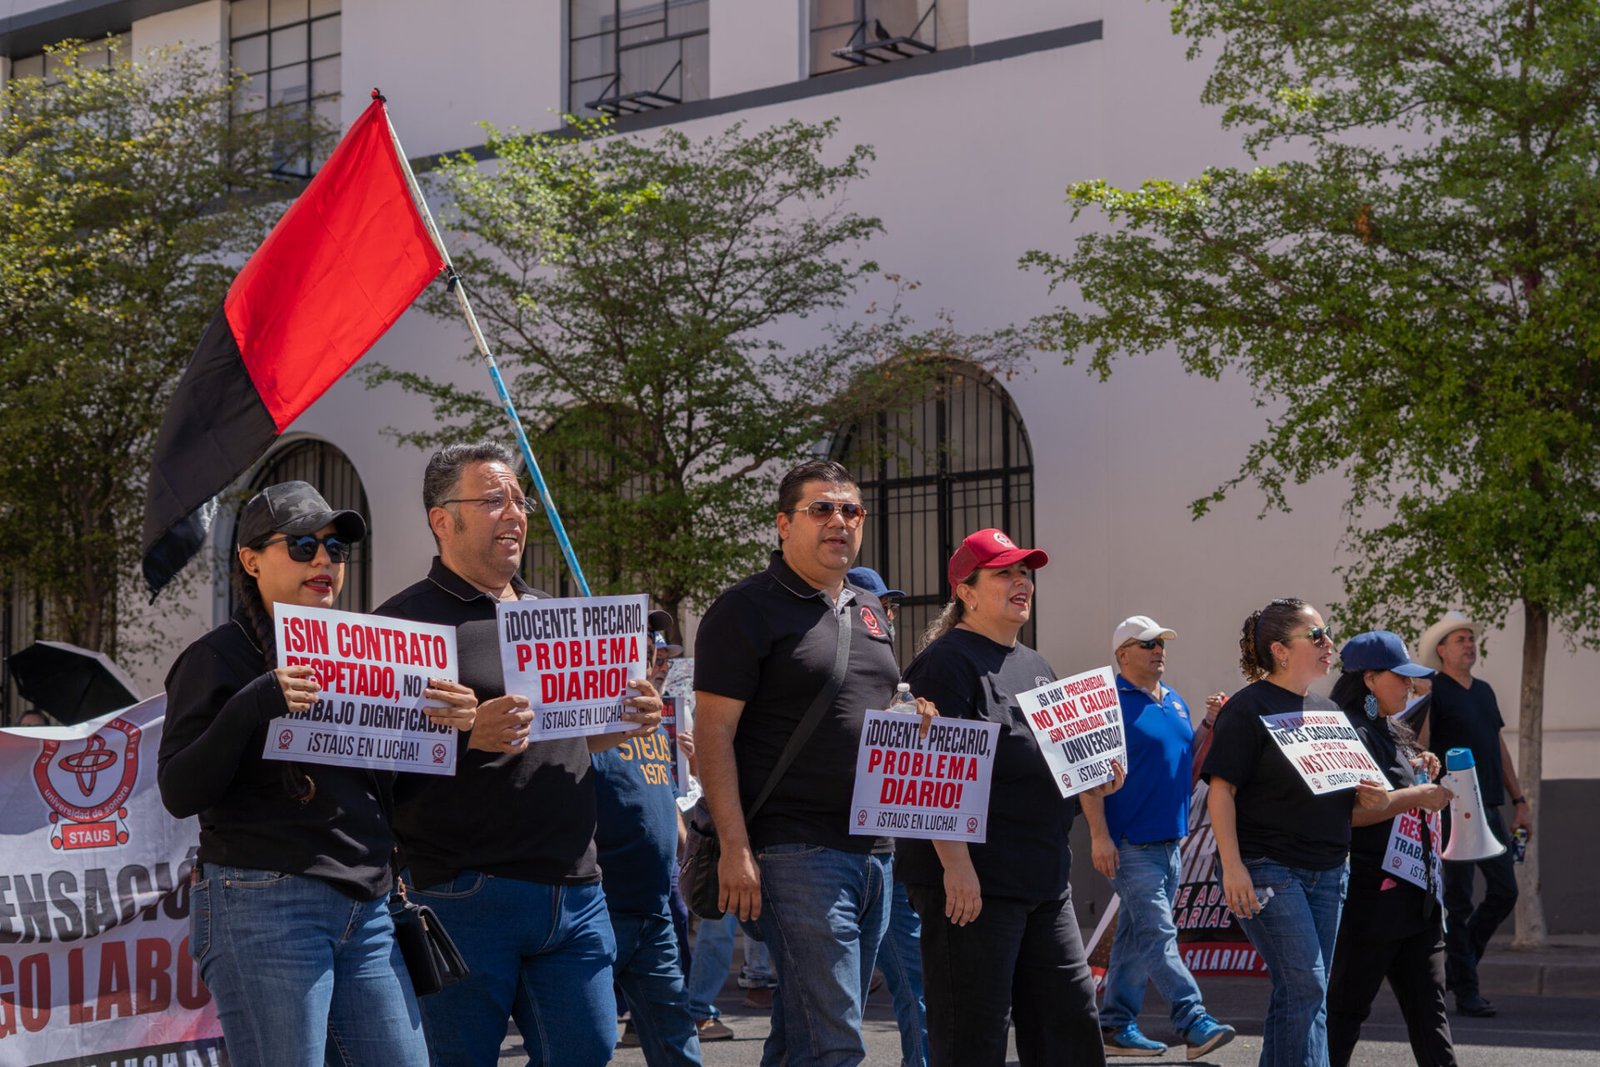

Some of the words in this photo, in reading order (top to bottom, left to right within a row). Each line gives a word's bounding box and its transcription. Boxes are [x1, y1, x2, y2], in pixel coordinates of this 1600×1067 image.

[505, 607, 578, 643] ¡DOCENTE
[582, 603, 645, 637] PRECARIO,
[283, 617, 329, 655] ¡SIN
[336, 622, 447, 669] CONTRATO
[516, 636, 640, 672] PROBLEMA
[403, 674, 421, 697] NO
[541, 667, 628, 704] DIARIO!
[1048, 687, 1065, 703] HAY
[542, 708, 577, 730] ¡STAUS
[579, 706, 592, 726] EN
[1031, 709, 1054, 731] NO
[1051, 699, 1080, 724] HAY
[307, 732, 354, 756] ¡STAUS
[357, 737, 372, 757] EN
[377, 739, 420, 761] LUCHA!
[928, 724, 991, 759] PRECARIO,
[1273, 730, 1294, 746] NO
[639, 763, 669, 785] 1976
[868, 749, 977, 781] PROBLEMA
[879, 777, 963, 810] DIARIO!
[877, 811, 910, 829] ¡STAUS
[911, 813, 923, 830] EN
[925, 815, 957, 832] LUCHA!
[69, 829, 111, 844] STAUS
[1173, 906, 1232, 930] ARIAL
[1184, 949, 1257, 971] SALARIAL
